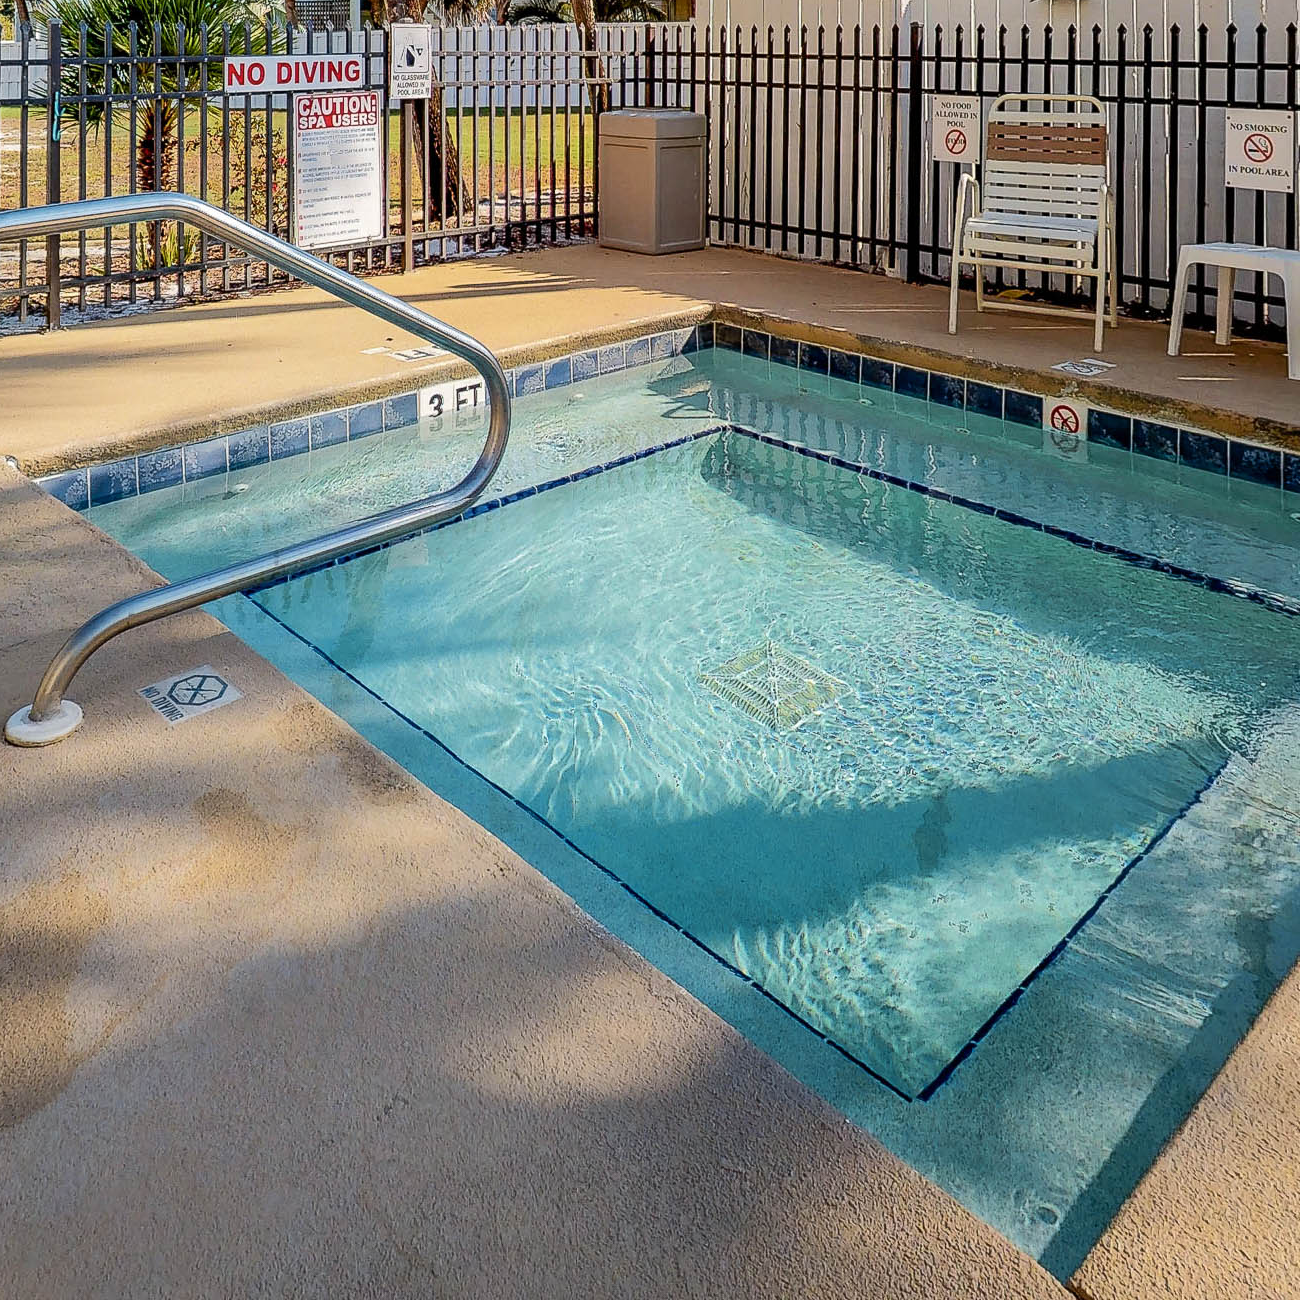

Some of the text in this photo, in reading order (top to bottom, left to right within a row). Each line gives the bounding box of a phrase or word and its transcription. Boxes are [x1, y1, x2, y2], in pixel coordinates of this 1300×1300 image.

[227, 60, 360, 87] NO DIVING
[299, 96, 377, 116] CAUTION:
[941, 101, 972, 110] NO FOOD
[299, 112, 377, 129] SPA USERS
[934, 110, 969, 118] ALLOWED
[947, 120, 966, 128] POOL
[1229, 122, 1288, 133] NO SMOKING
[1240, 166, 1264, 175] POOL
[1265, 168, 1290, 177] AREA
[428, 382, 483, 418] 3 FT
[139, 686, 184, 722] NO DIVING
